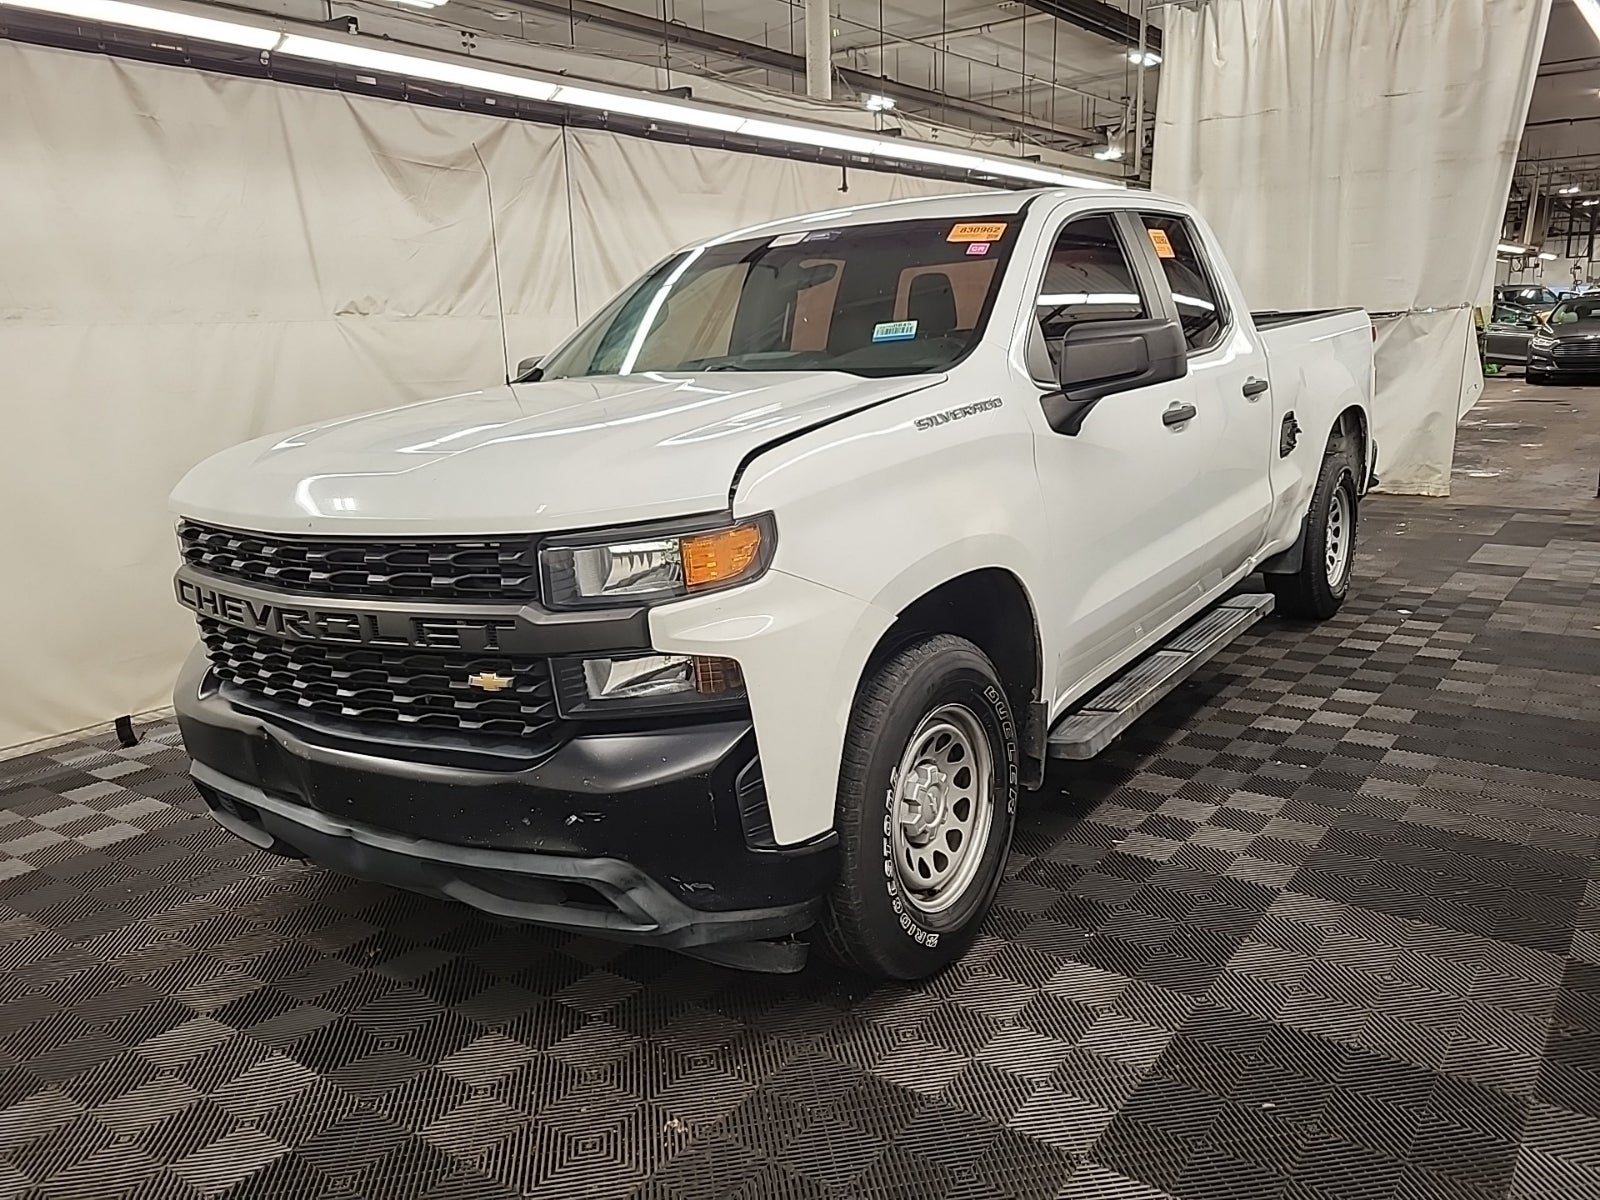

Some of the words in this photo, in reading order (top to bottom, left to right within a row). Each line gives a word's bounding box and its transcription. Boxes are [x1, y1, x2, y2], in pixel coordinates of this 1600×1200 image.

[959, 226, 1001, 234] 830962
[913, 397, 1003, 431] SILVERADO
[178, 579, 517, 650] CHEVROLET
[984, 685, 1018, 815] DUELER
